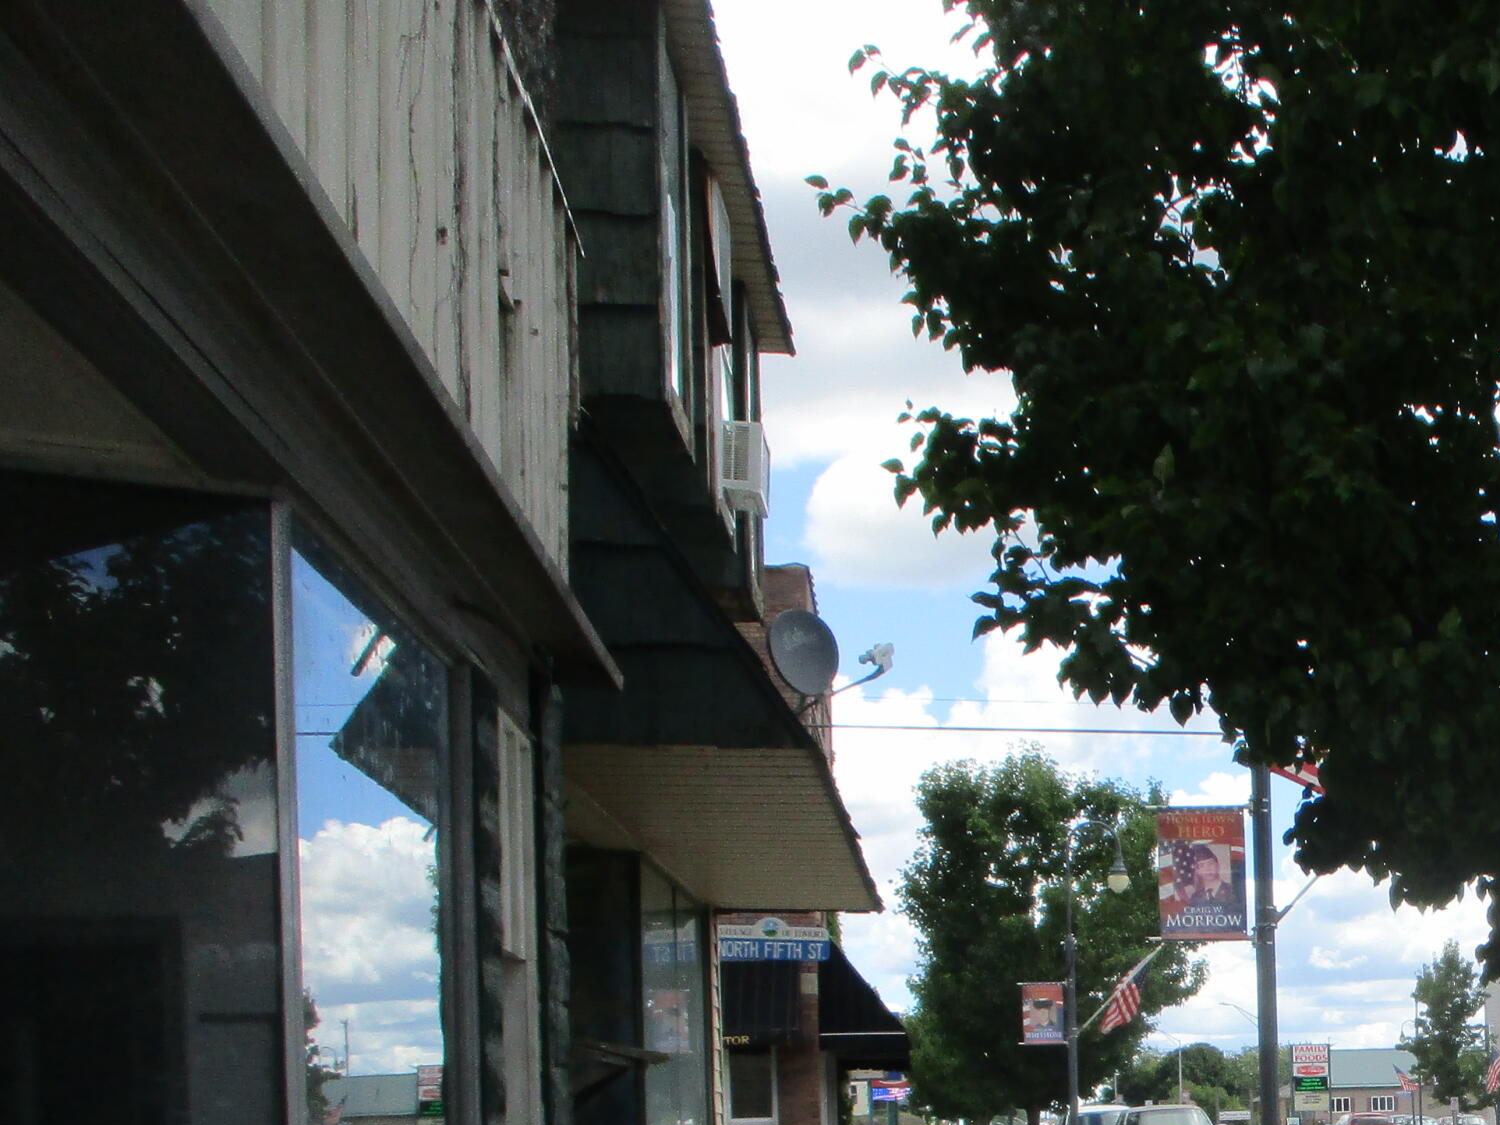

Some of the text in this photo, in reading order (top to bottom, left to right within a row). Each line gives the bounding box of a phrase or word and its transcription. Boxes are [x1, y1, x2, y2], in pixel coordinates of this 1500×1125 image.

[1179, 825, 1225, 838] HERO
[1183, 905, 1212, 915] CRAIG
[1166, 914, 1242, 928] MORROW
[720, 940, 759, 958] NORTH
[764, 942, 802, 959] FIFTH
[1294, 1045, 1328, 1053] FAMILY
